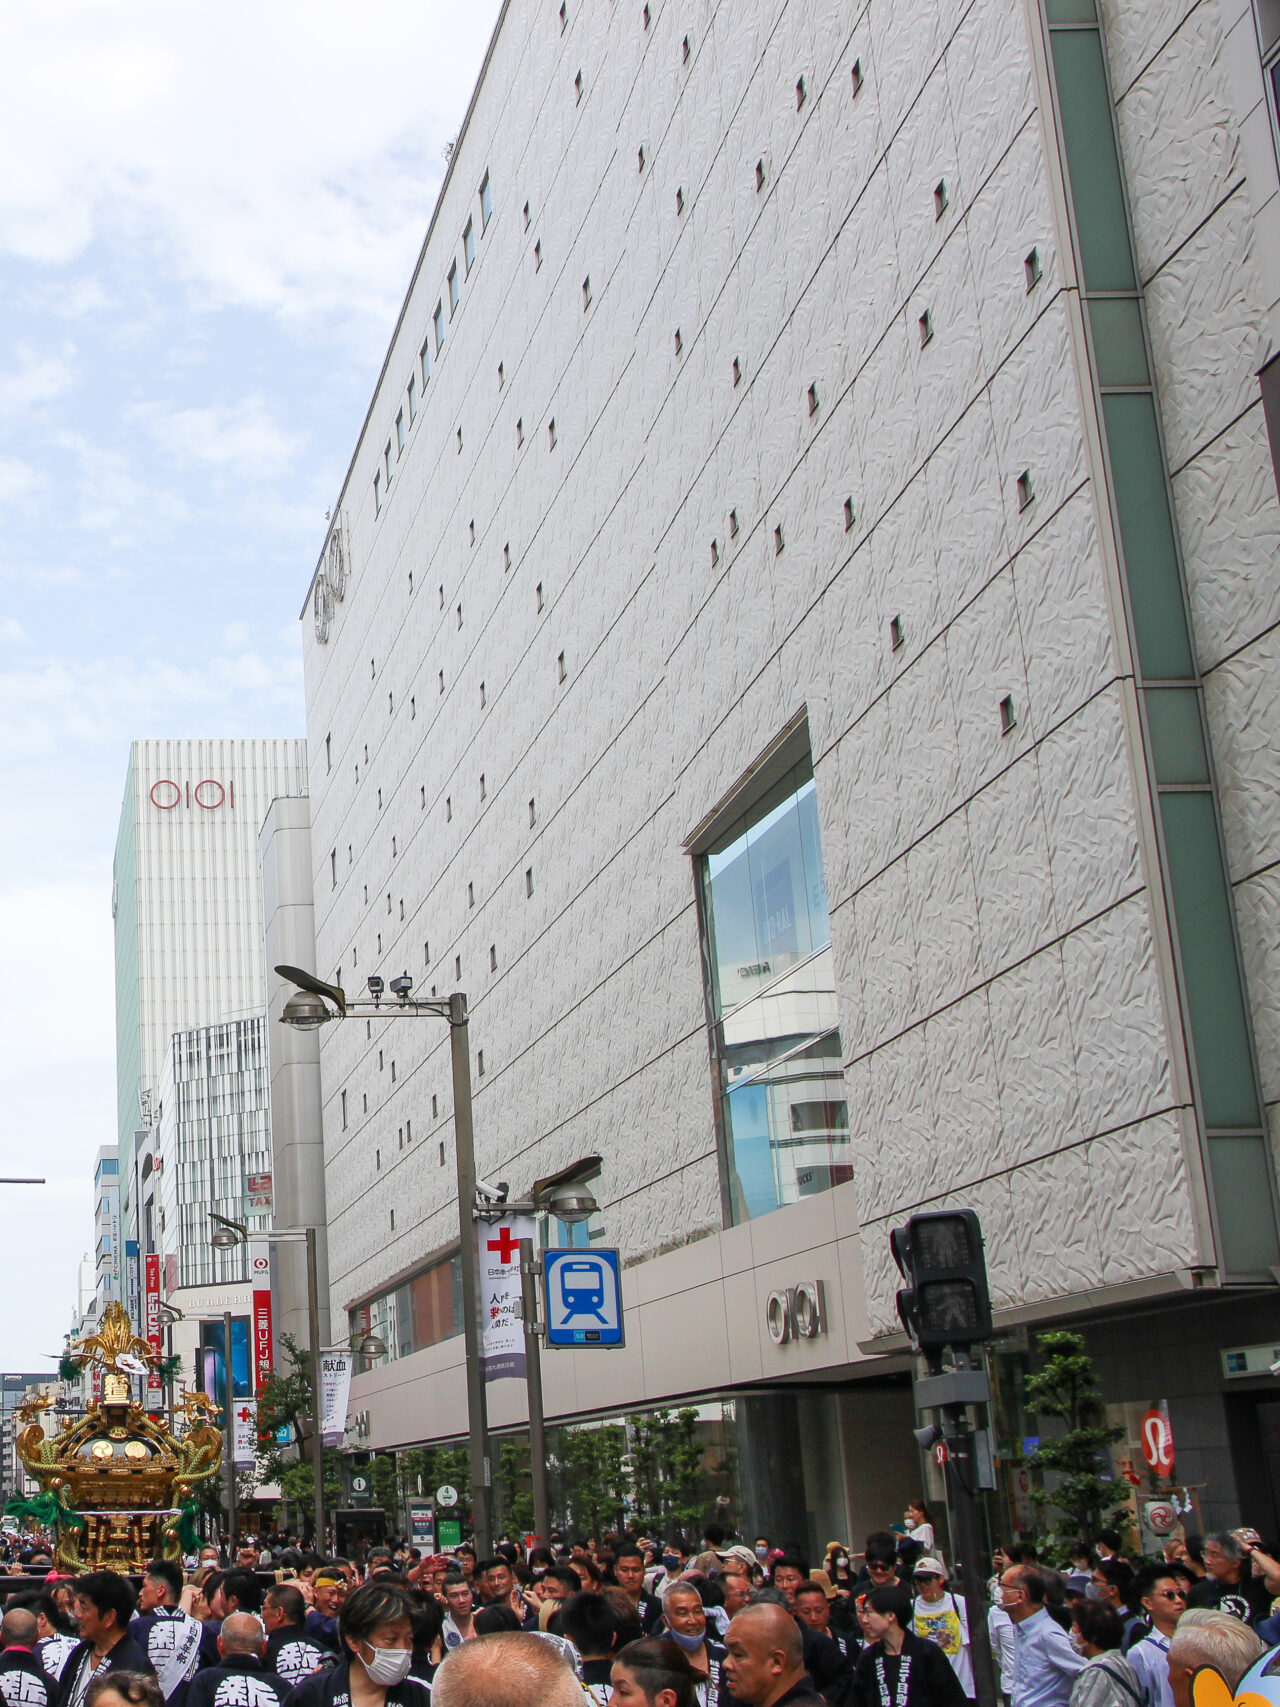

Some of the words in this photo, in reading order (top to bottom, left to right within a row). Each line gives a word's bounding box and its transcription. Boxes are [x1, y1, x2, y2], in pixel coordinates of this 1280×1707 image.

[248, 1195, 271, 1207] TAX
[189, 1294, 252, 1309] BURBERR
[322, 1359, 347, 1372] 献血
